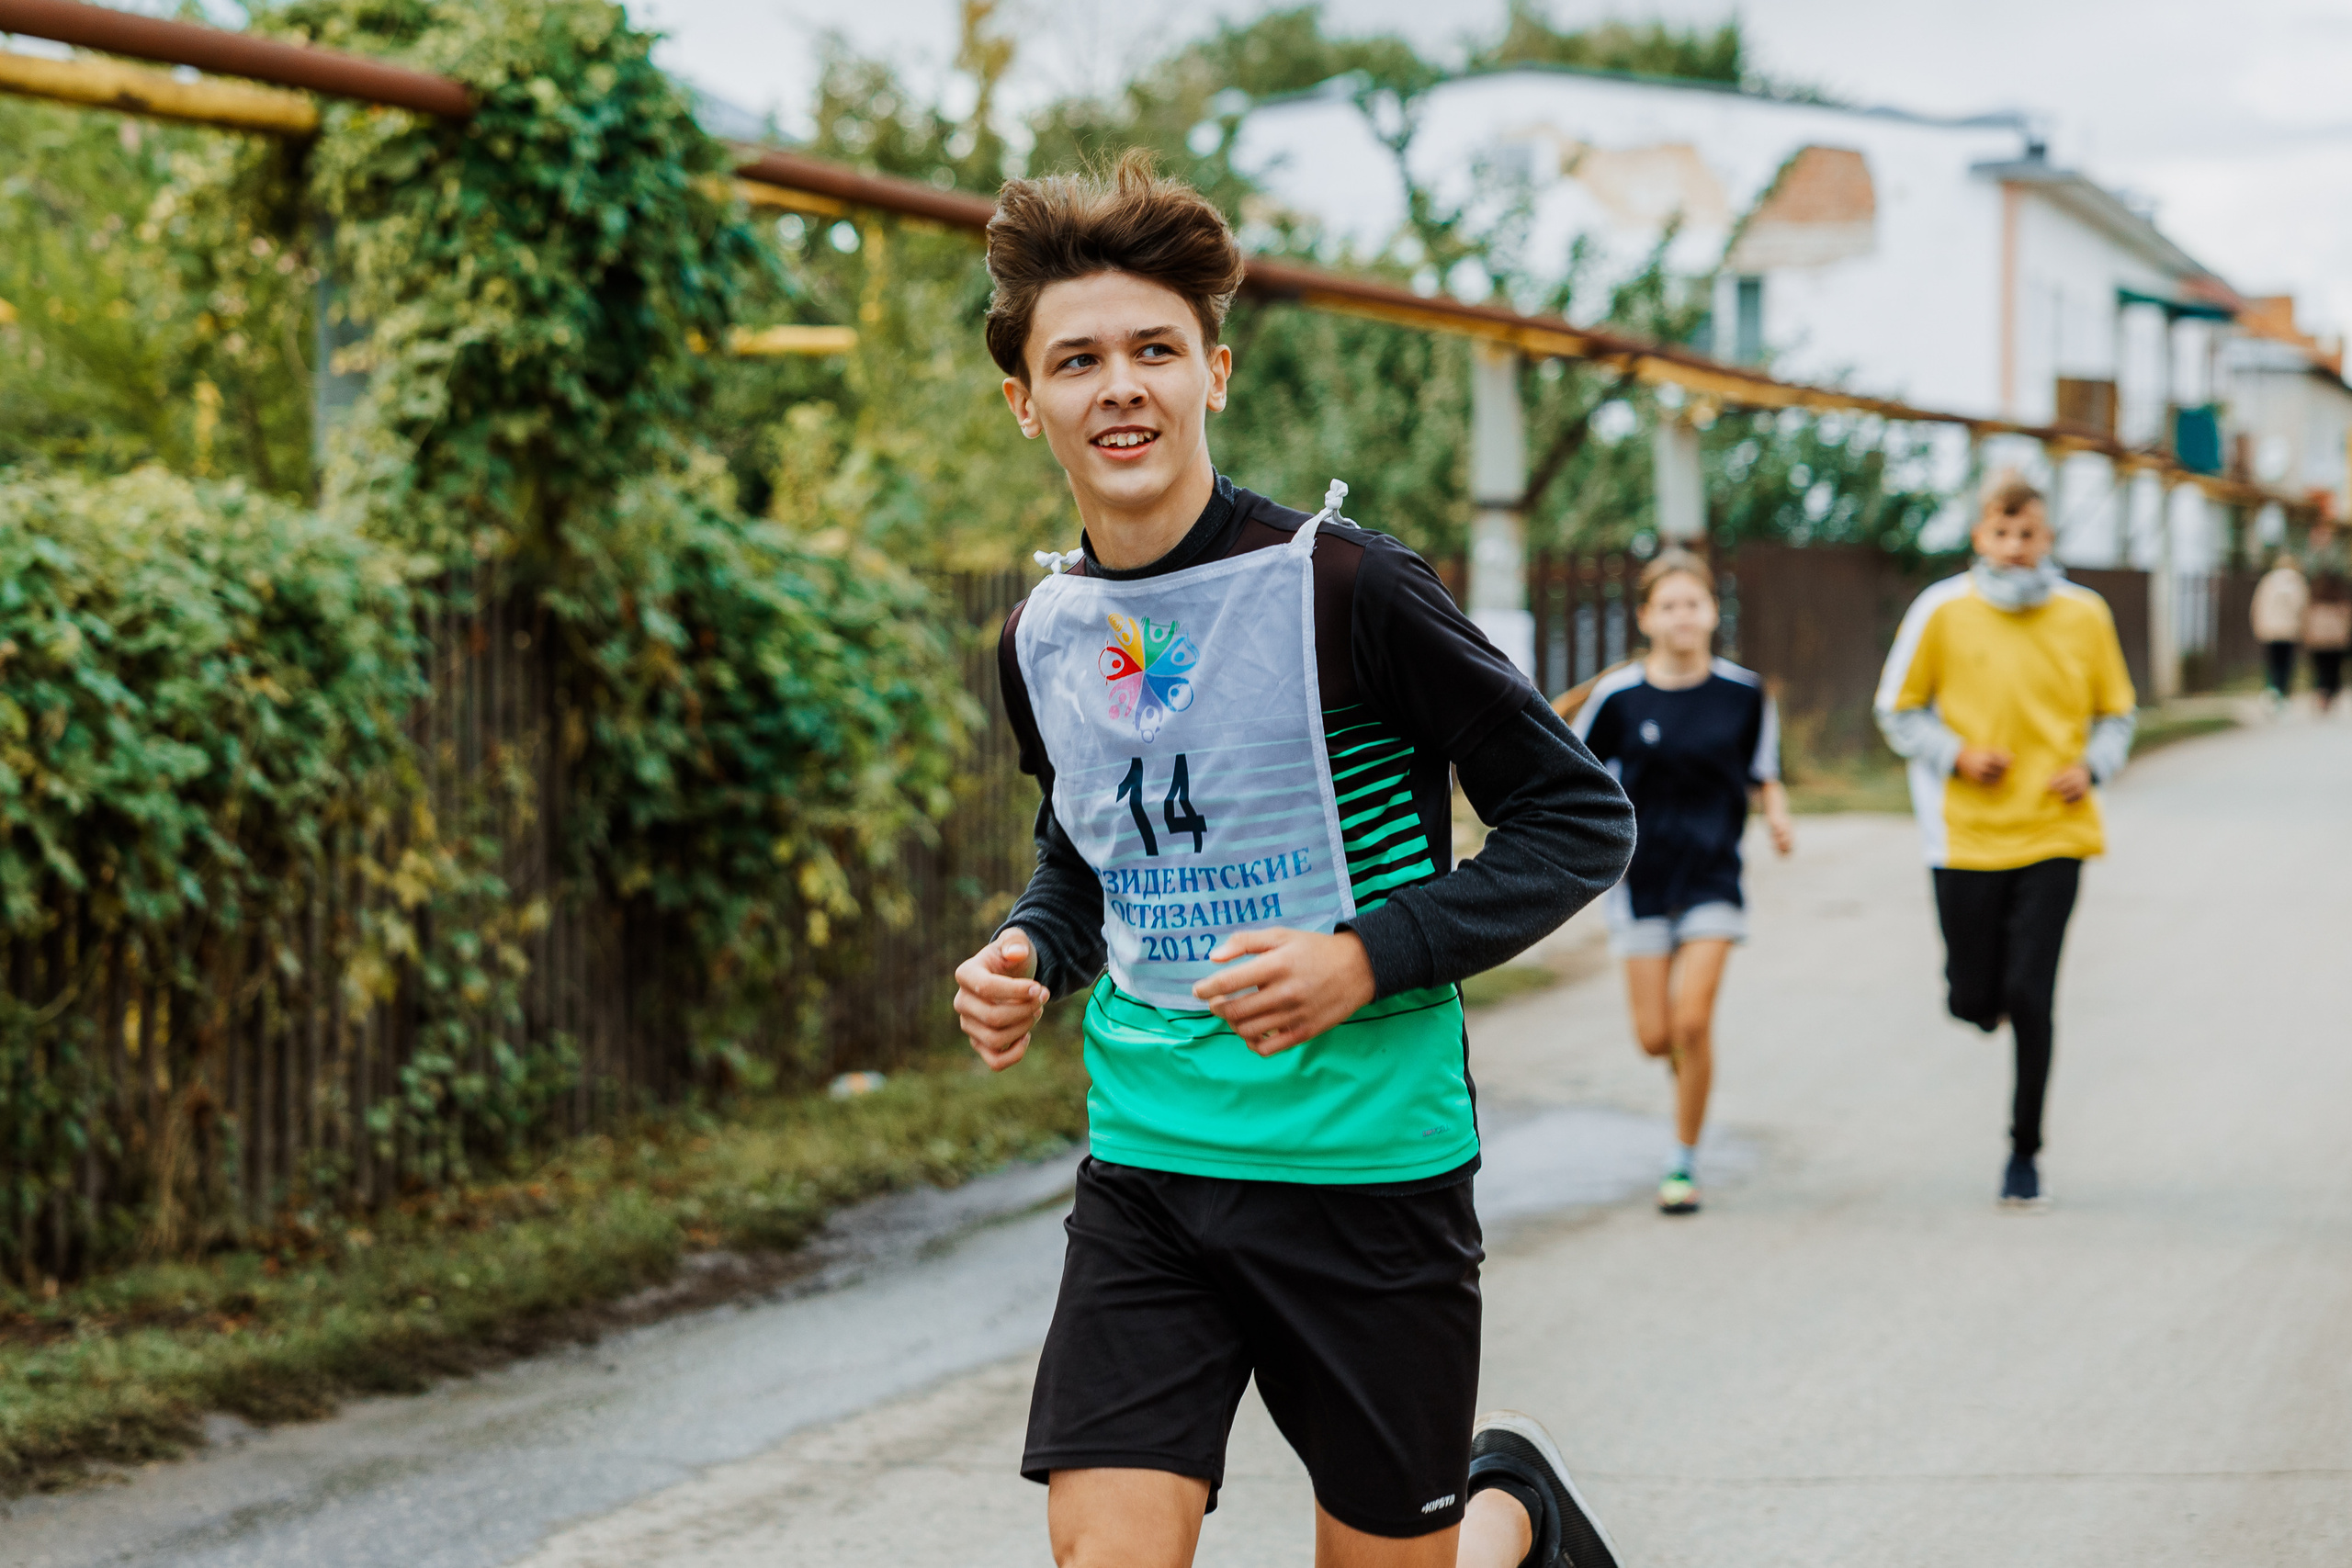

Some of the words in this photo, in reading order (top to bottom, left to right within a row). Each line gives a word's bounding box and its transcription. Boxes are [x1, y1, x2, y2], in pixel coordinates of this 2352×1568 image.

[1115, 753, 1208, 857] 14
[1094, 847, 1312, 900] ЗИДЕНТСКИЕ
[1142, 933, 1217, 963] 2012
